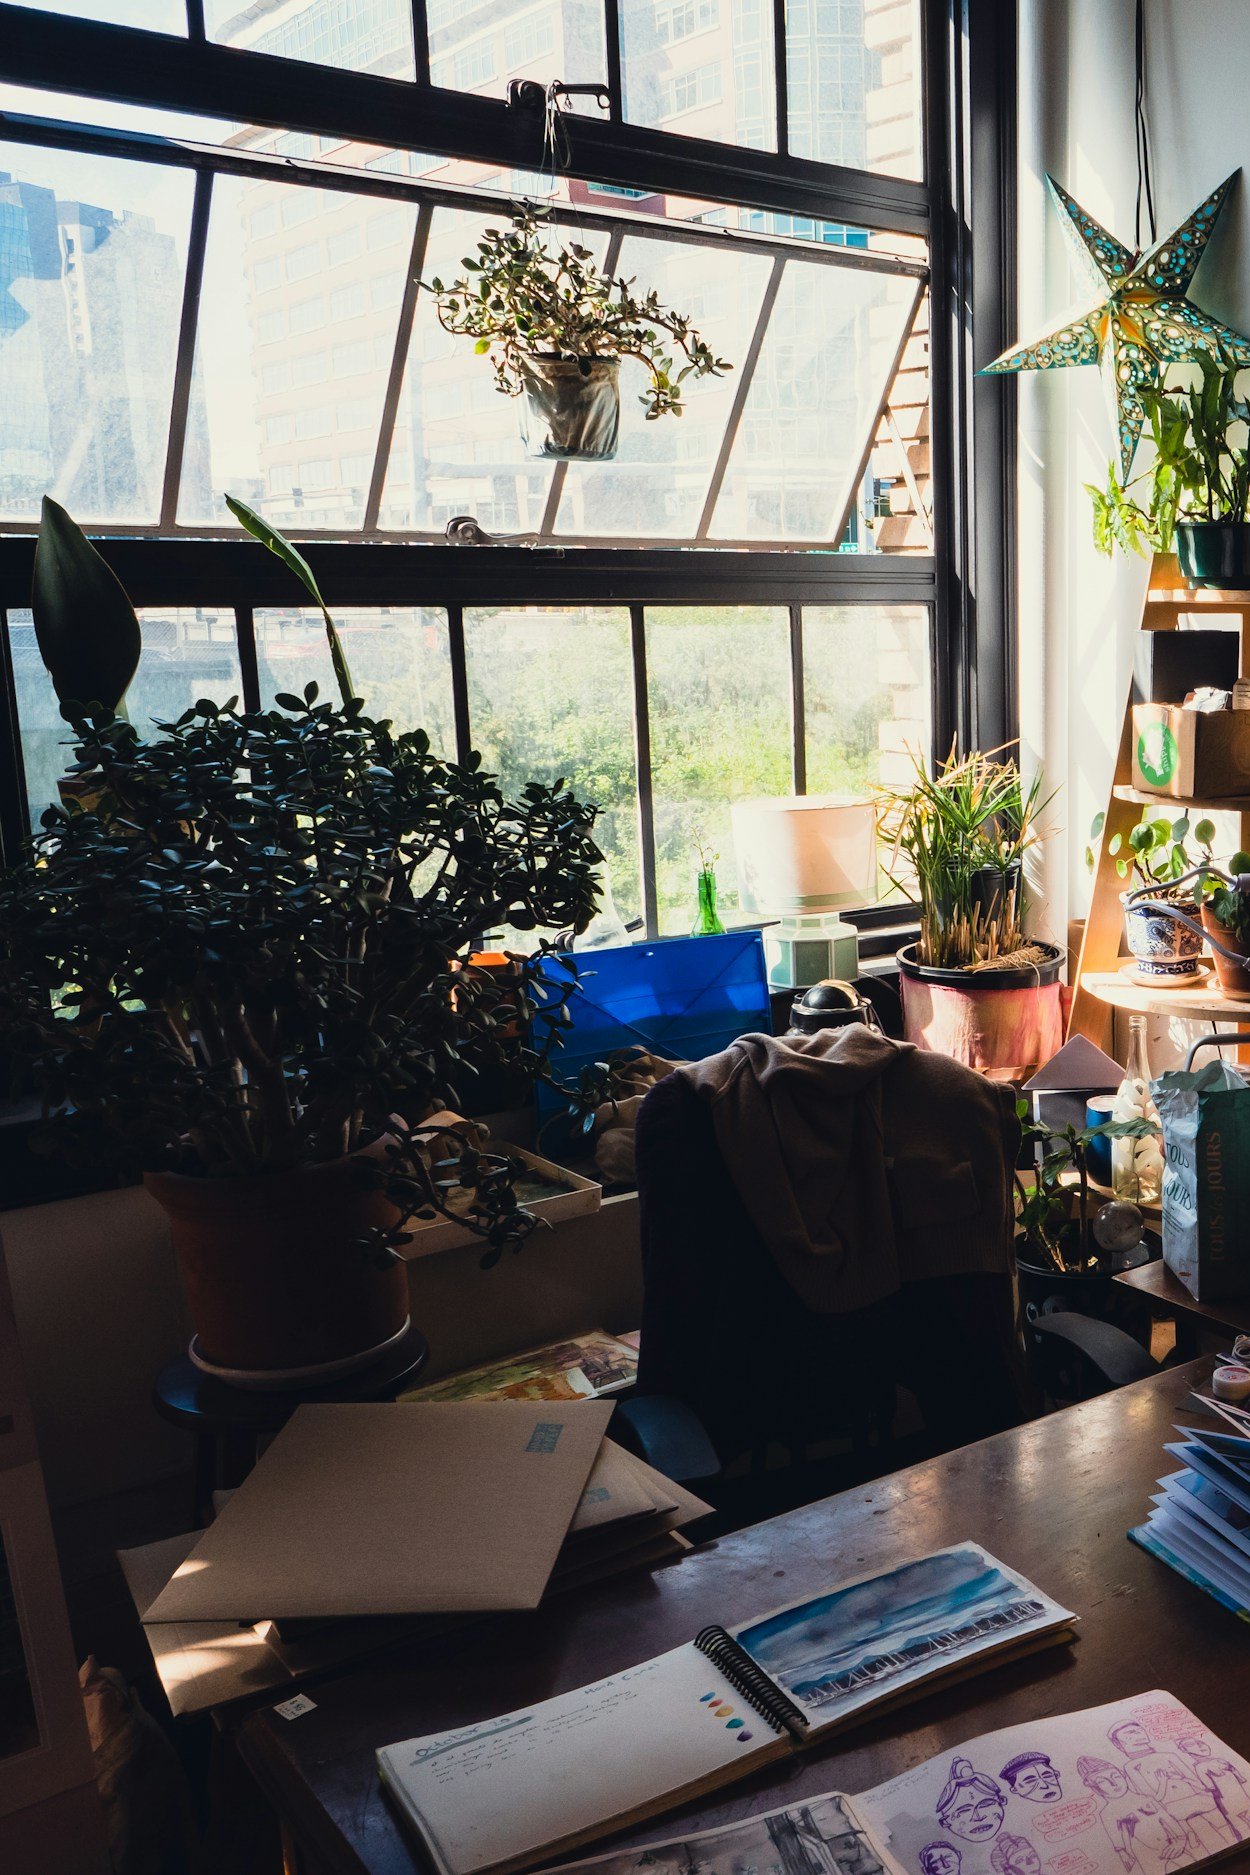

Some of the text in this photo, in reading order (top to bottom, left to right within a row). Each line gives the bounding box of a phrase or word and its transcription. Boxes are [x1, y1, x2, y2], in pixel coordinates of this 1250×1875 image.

[1165, 1142, 1190, 1169] TOUS
[1206, 1131, 1226, 1192] JOURS
[1208, 1216, 1225, 1261] TOUS
[416, 1724, 483, 1757] October
